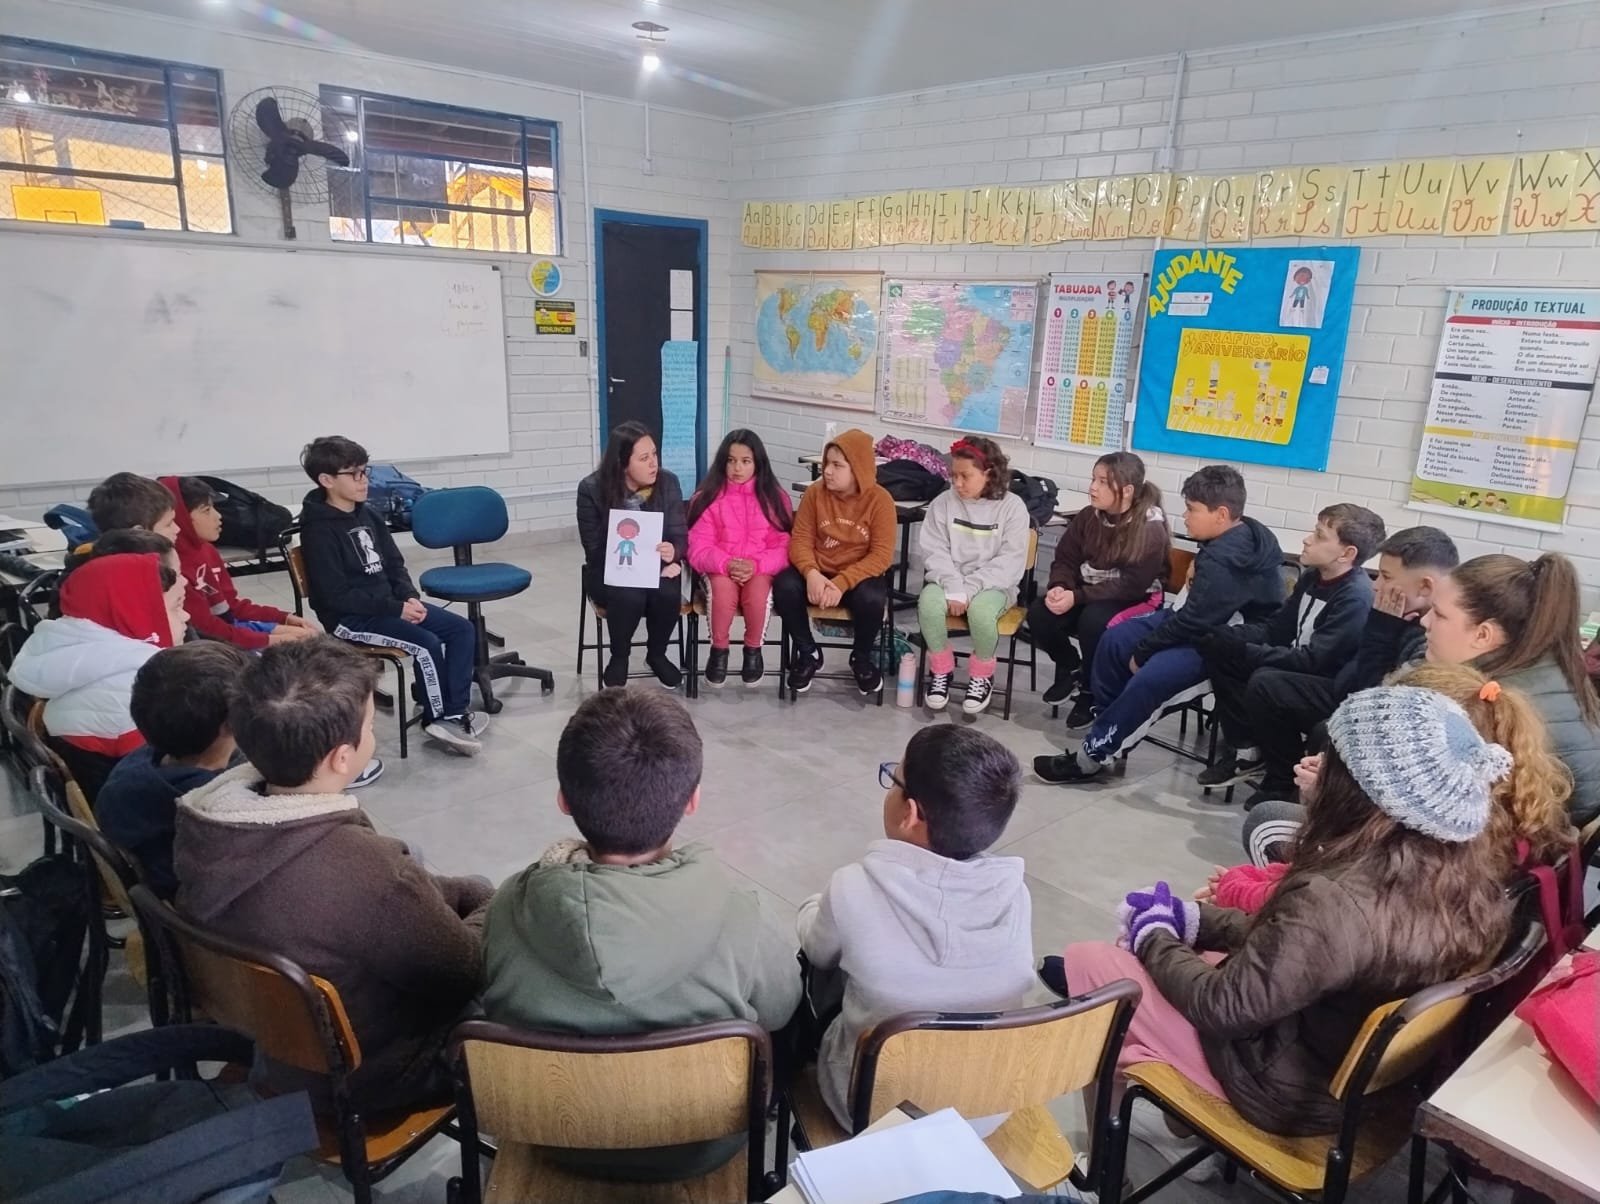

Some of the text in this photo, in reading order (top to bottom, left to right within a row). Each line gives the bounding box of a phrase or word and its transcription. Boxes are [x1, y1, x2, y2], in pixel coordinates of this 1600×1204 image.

[1054, 284, 1102, 294] TABUADA
[1148, 250, 1244, 318] AJUDANTE
[1472, 298, 1586, 314] PRODUÇÃO TEXTUAL
[1193, 342, 1306, 362] ANIVERSÁRIO
